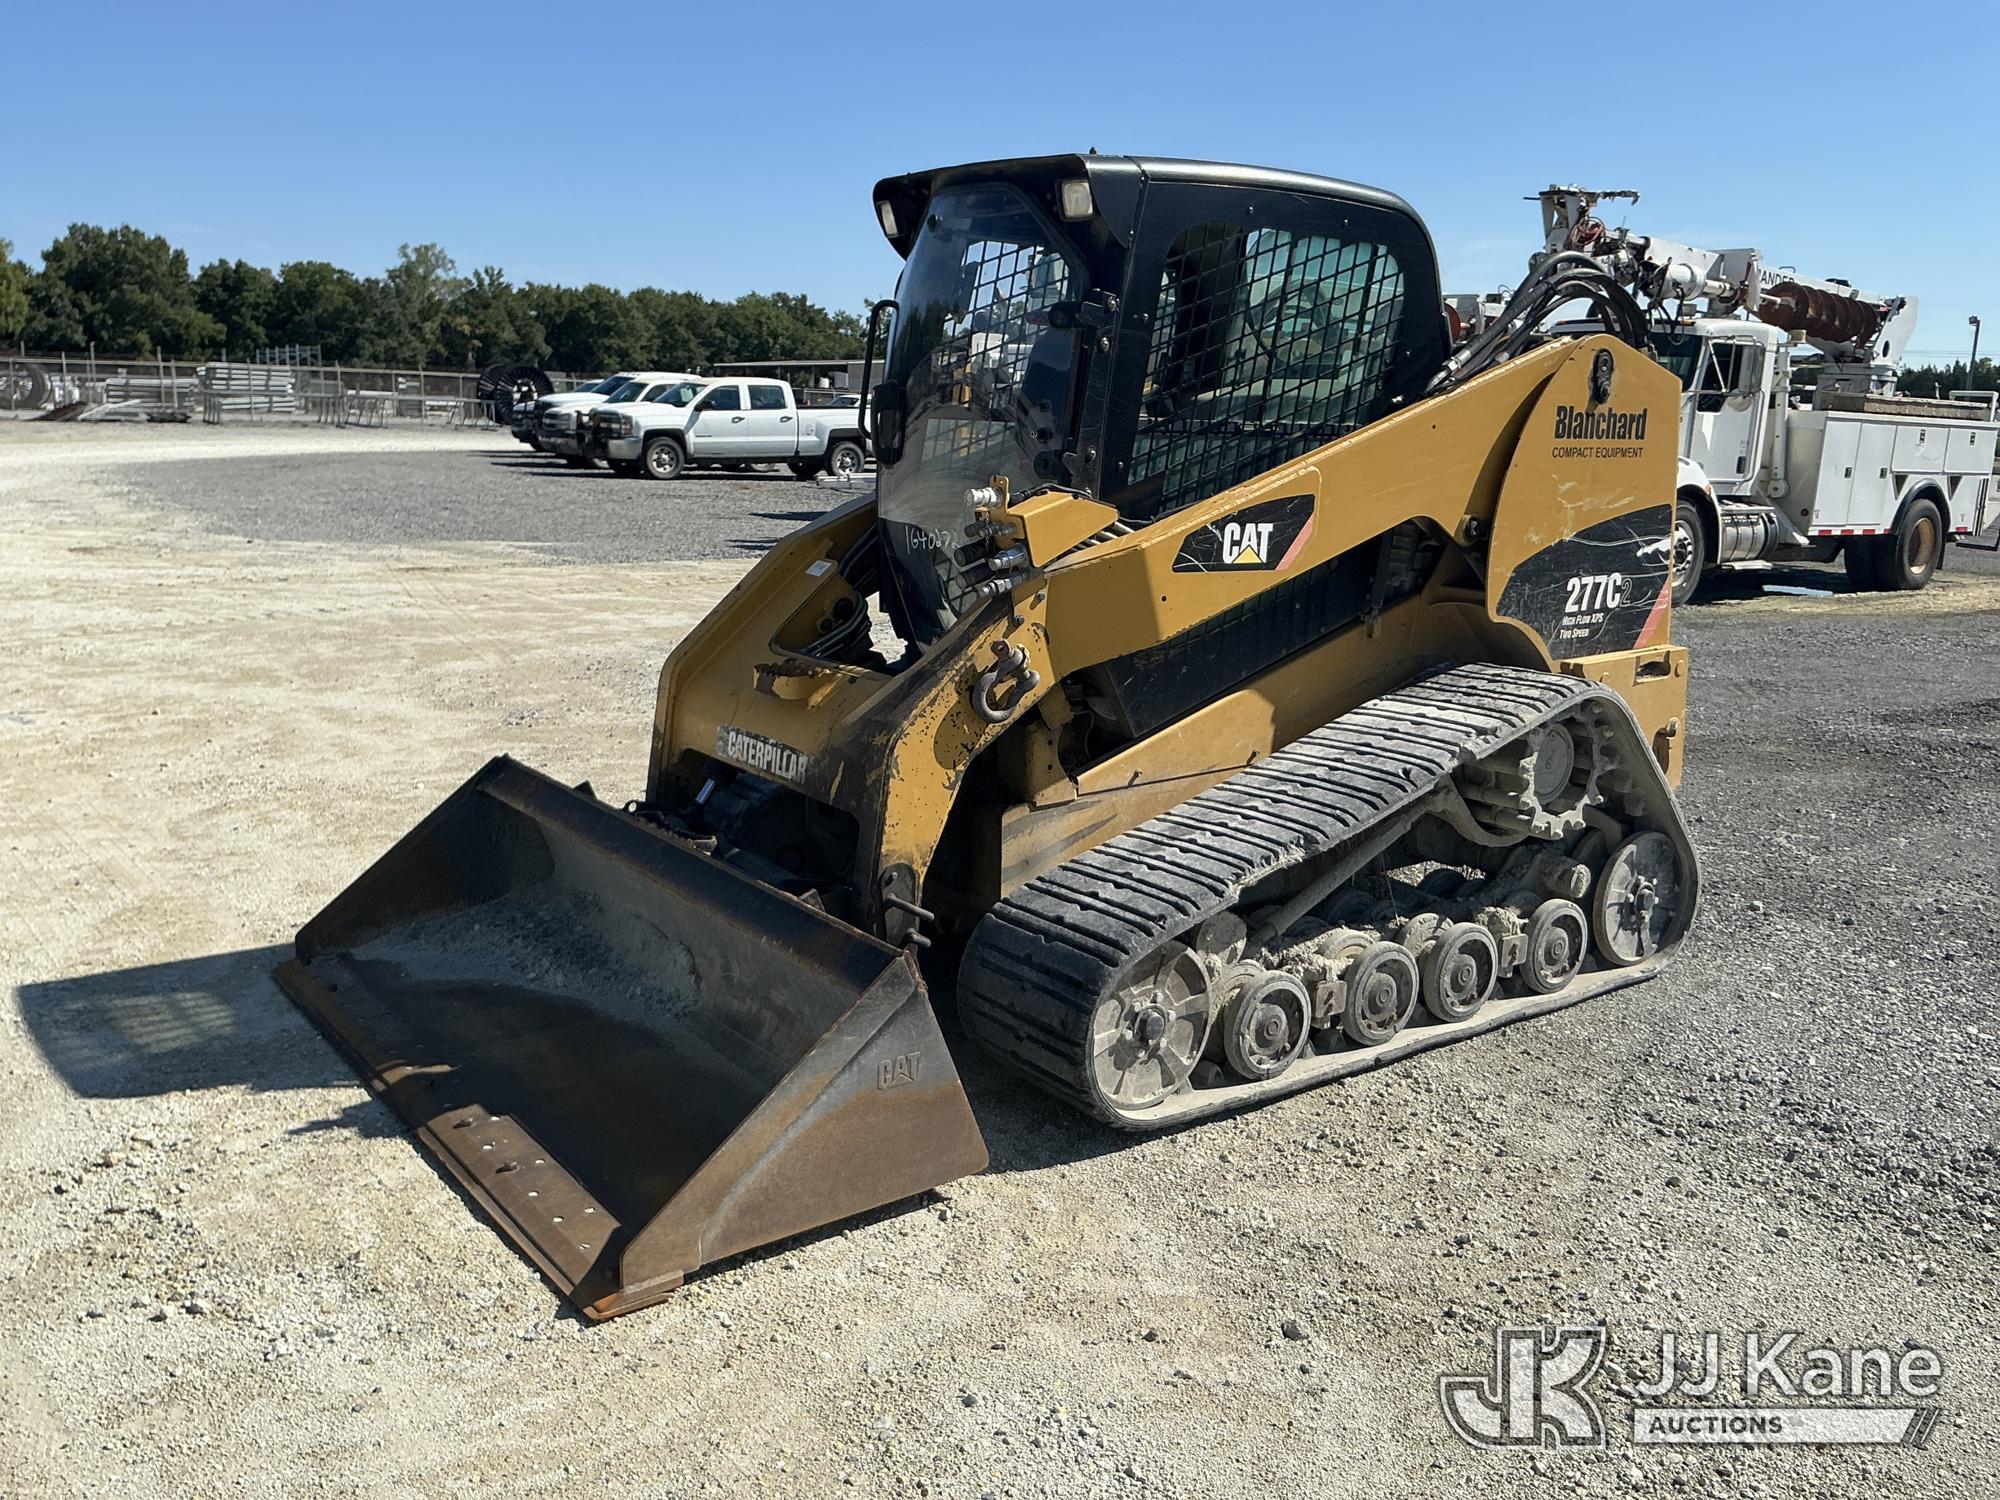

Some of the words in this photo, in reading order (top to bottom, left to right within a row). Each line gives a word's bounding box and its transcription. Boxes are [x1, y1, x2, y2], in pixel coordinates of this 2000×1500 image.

[1555, 405, 1648, 440] Blanchard
[1552, 446, 1594, 458] COMPACT
[1595, 447, 1644, 458] EQUIPMENT
[1222, 522, 1274, 564] CAT
[727, 730, 808, 784] CATERPILLAR
[877, 1050, 921, 1091] CAT
